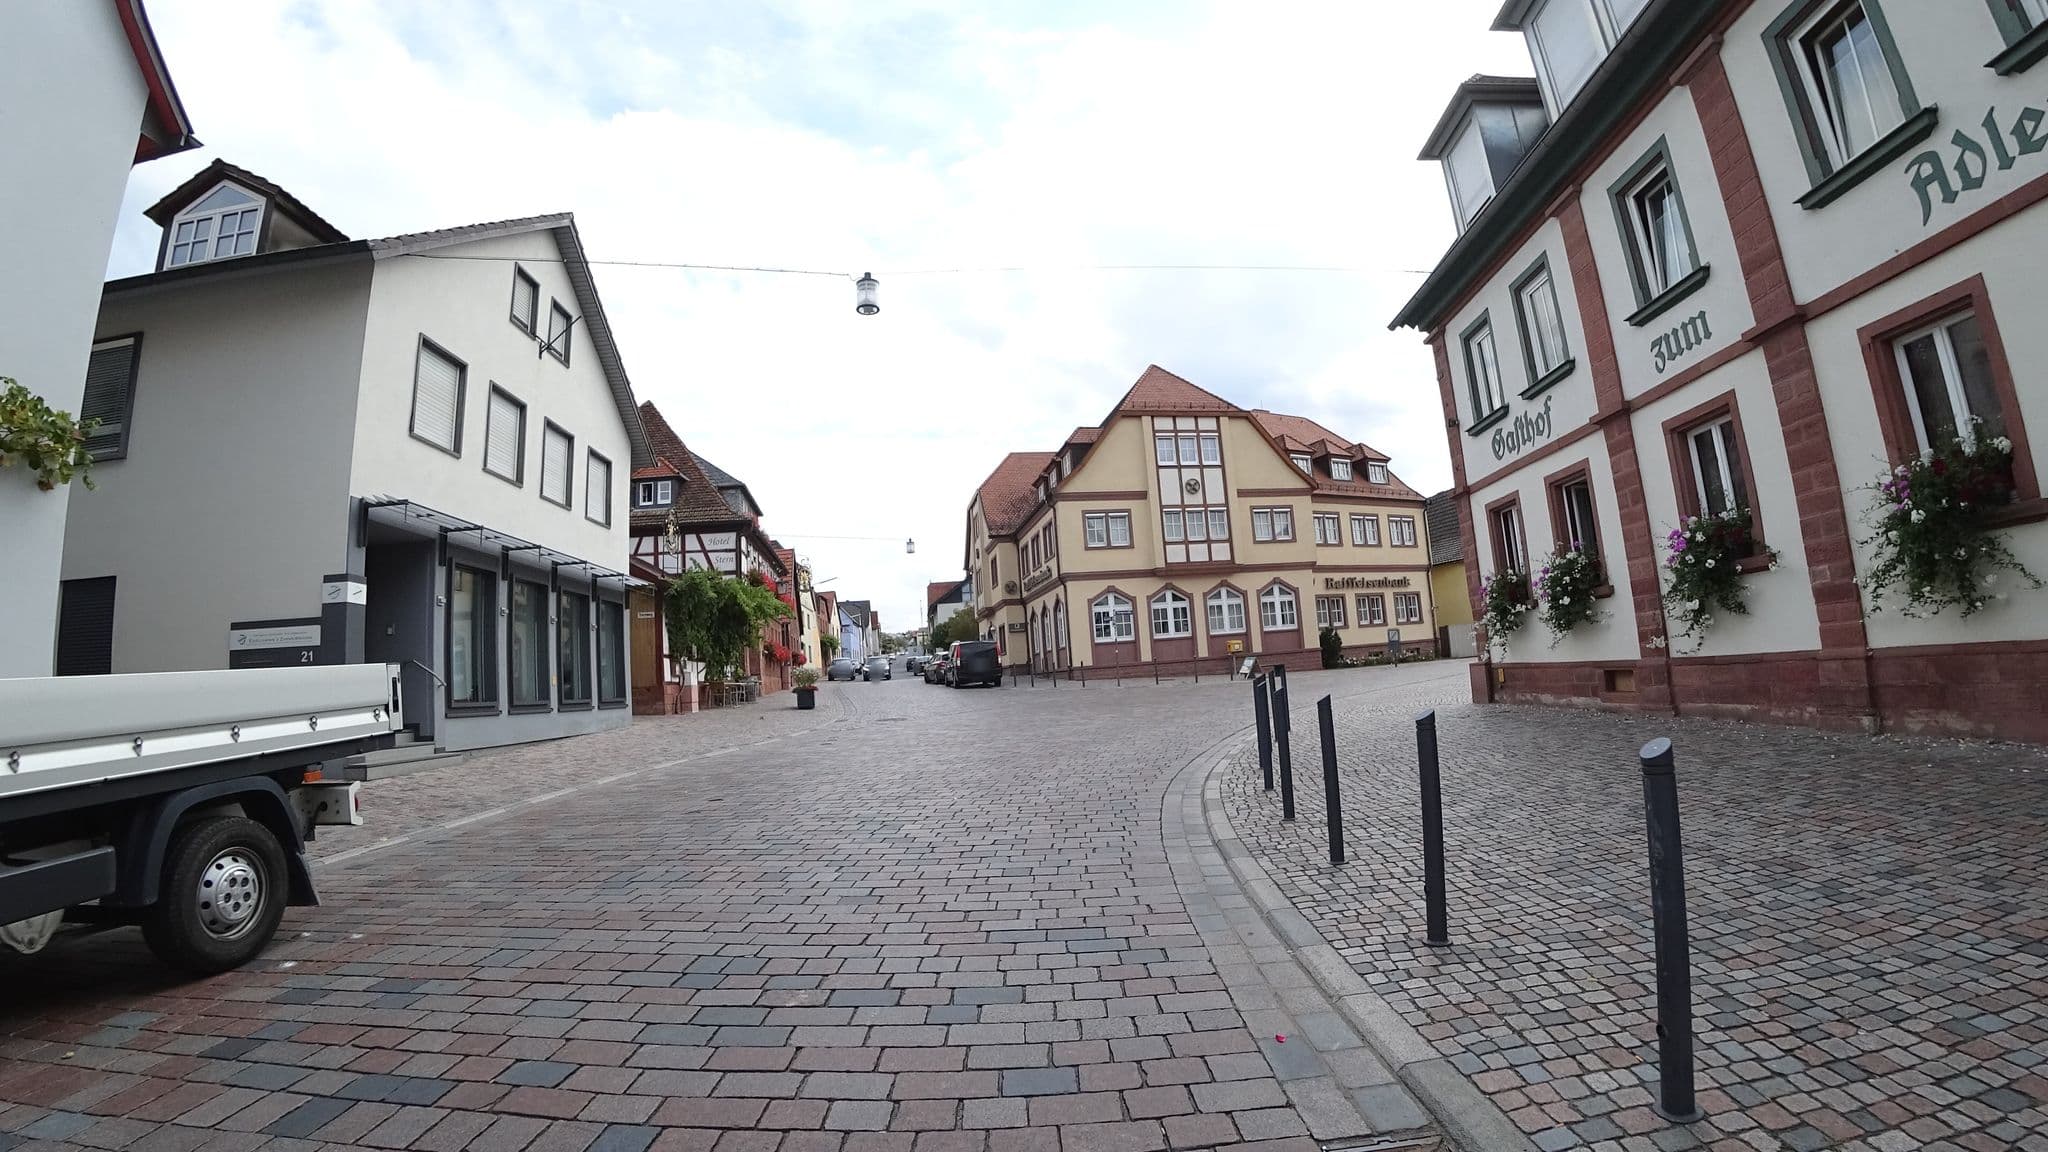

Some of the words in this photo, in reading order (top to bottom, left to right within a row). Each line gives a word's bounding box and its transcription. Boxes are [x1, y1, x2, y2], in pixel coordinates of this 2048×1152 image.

[1650, 310, 1712, 374] zum
[1903, 98, 2048, 227] Adle
[707, 535, 731, 546] Hotel
[1324, 576, 1411, 590] Raiffeisenbank
[300, 650, 314, 663] 21
